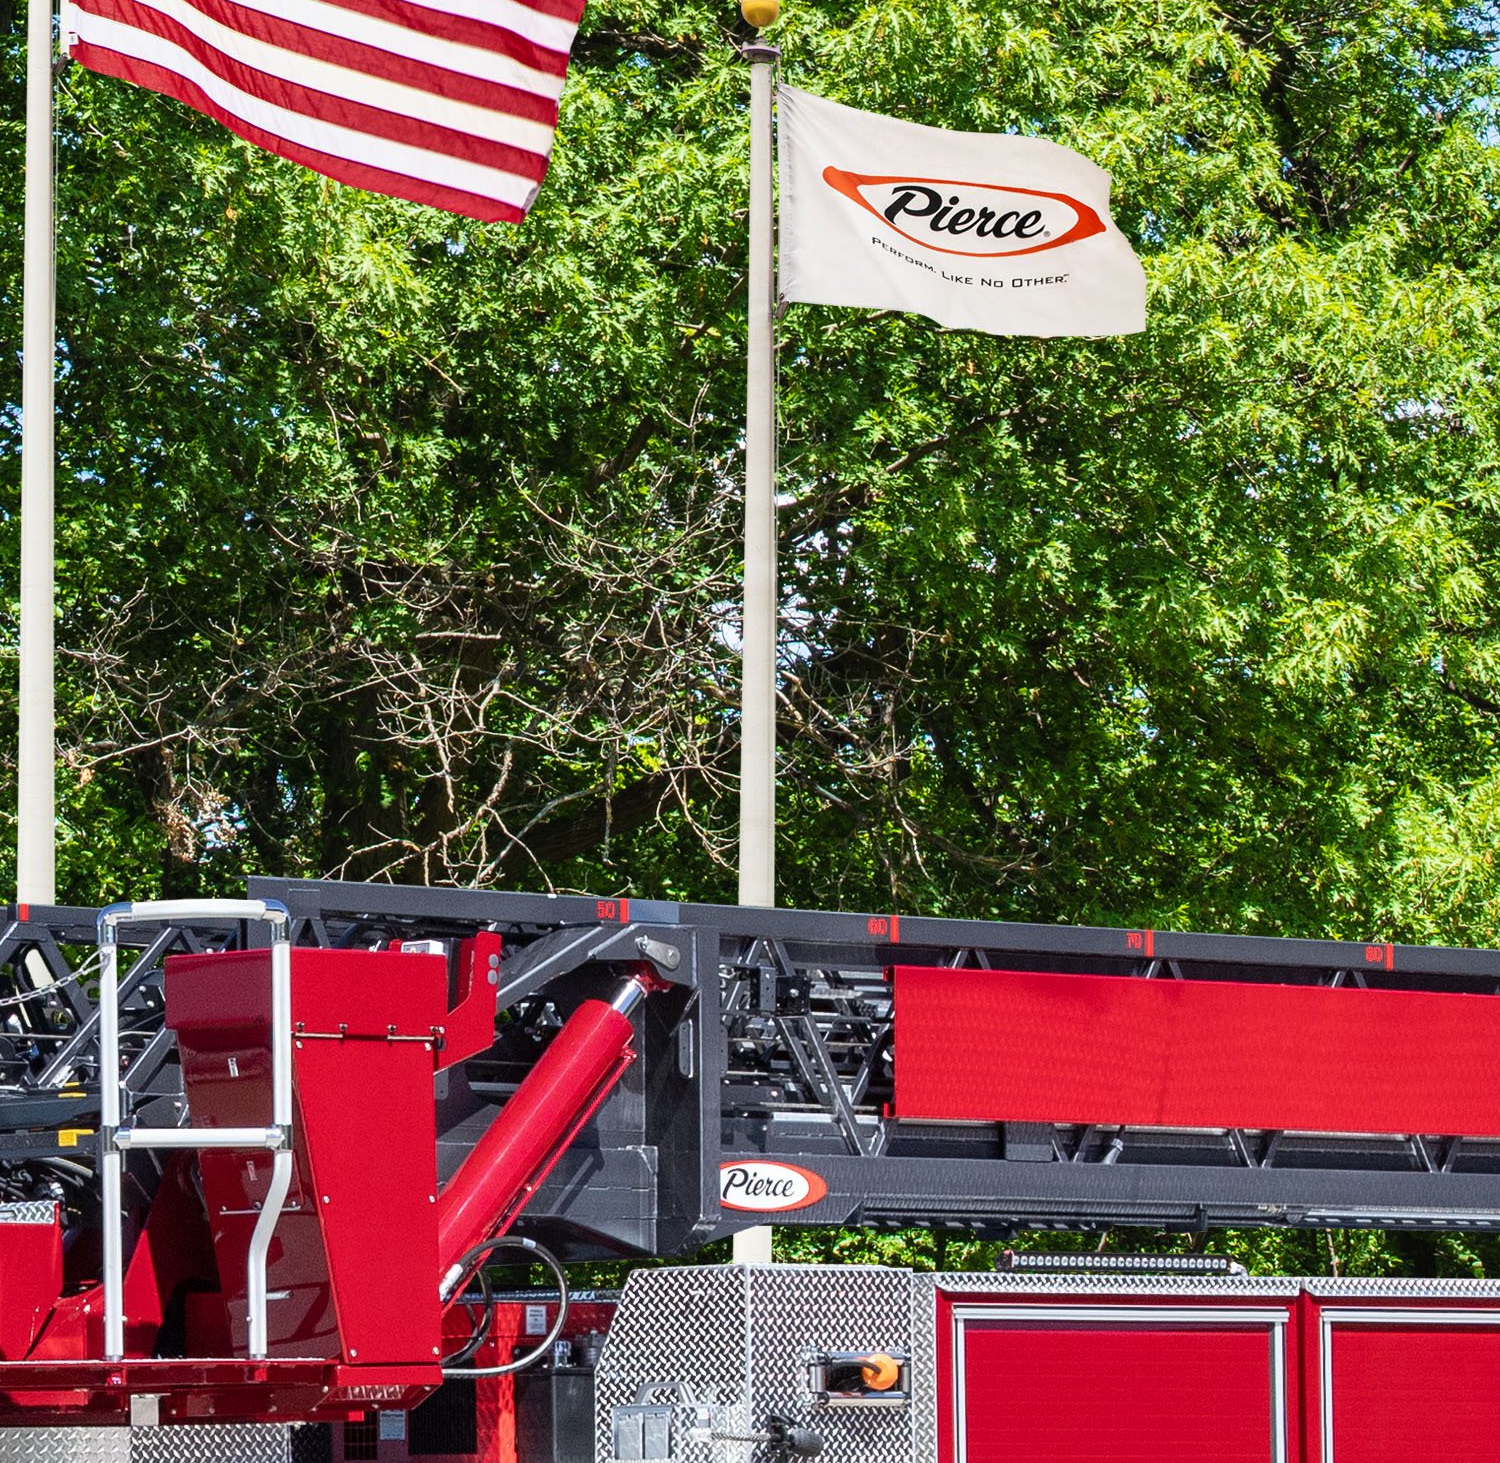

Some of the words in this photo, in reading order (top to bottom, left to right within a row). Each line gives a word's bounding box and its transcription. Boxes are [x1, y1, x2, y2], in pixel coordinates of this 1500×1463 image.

[884, 185, 1046, 239] Pierce
[871, 236, 937, 273] PERFORM.
[941, 270, 973, 285] LIKE
[596, 900, 616, 919] 50
[867, 917, 888, 935] 60
[1127, 932, 1143, 949] 70
[722, 1167, 795, 1200] Pierce
